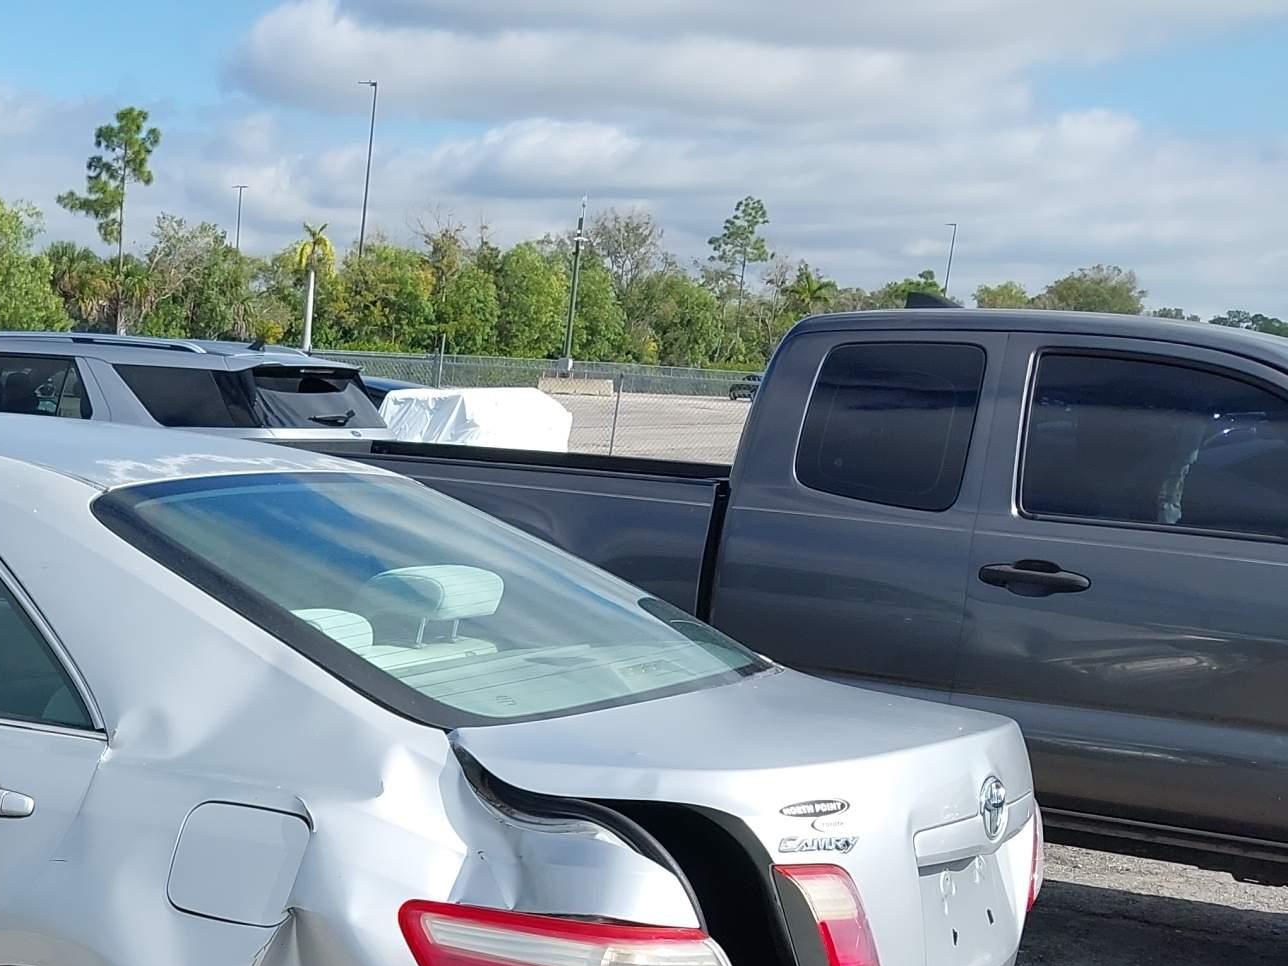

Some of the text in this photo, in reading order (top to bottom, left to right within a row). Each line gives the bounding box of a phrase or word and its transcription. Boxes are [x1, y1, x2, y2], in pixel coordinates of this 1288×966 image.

[782, 802, 842, 816] NORTH POINT
[778, 836, 859, 854] CAMRY
